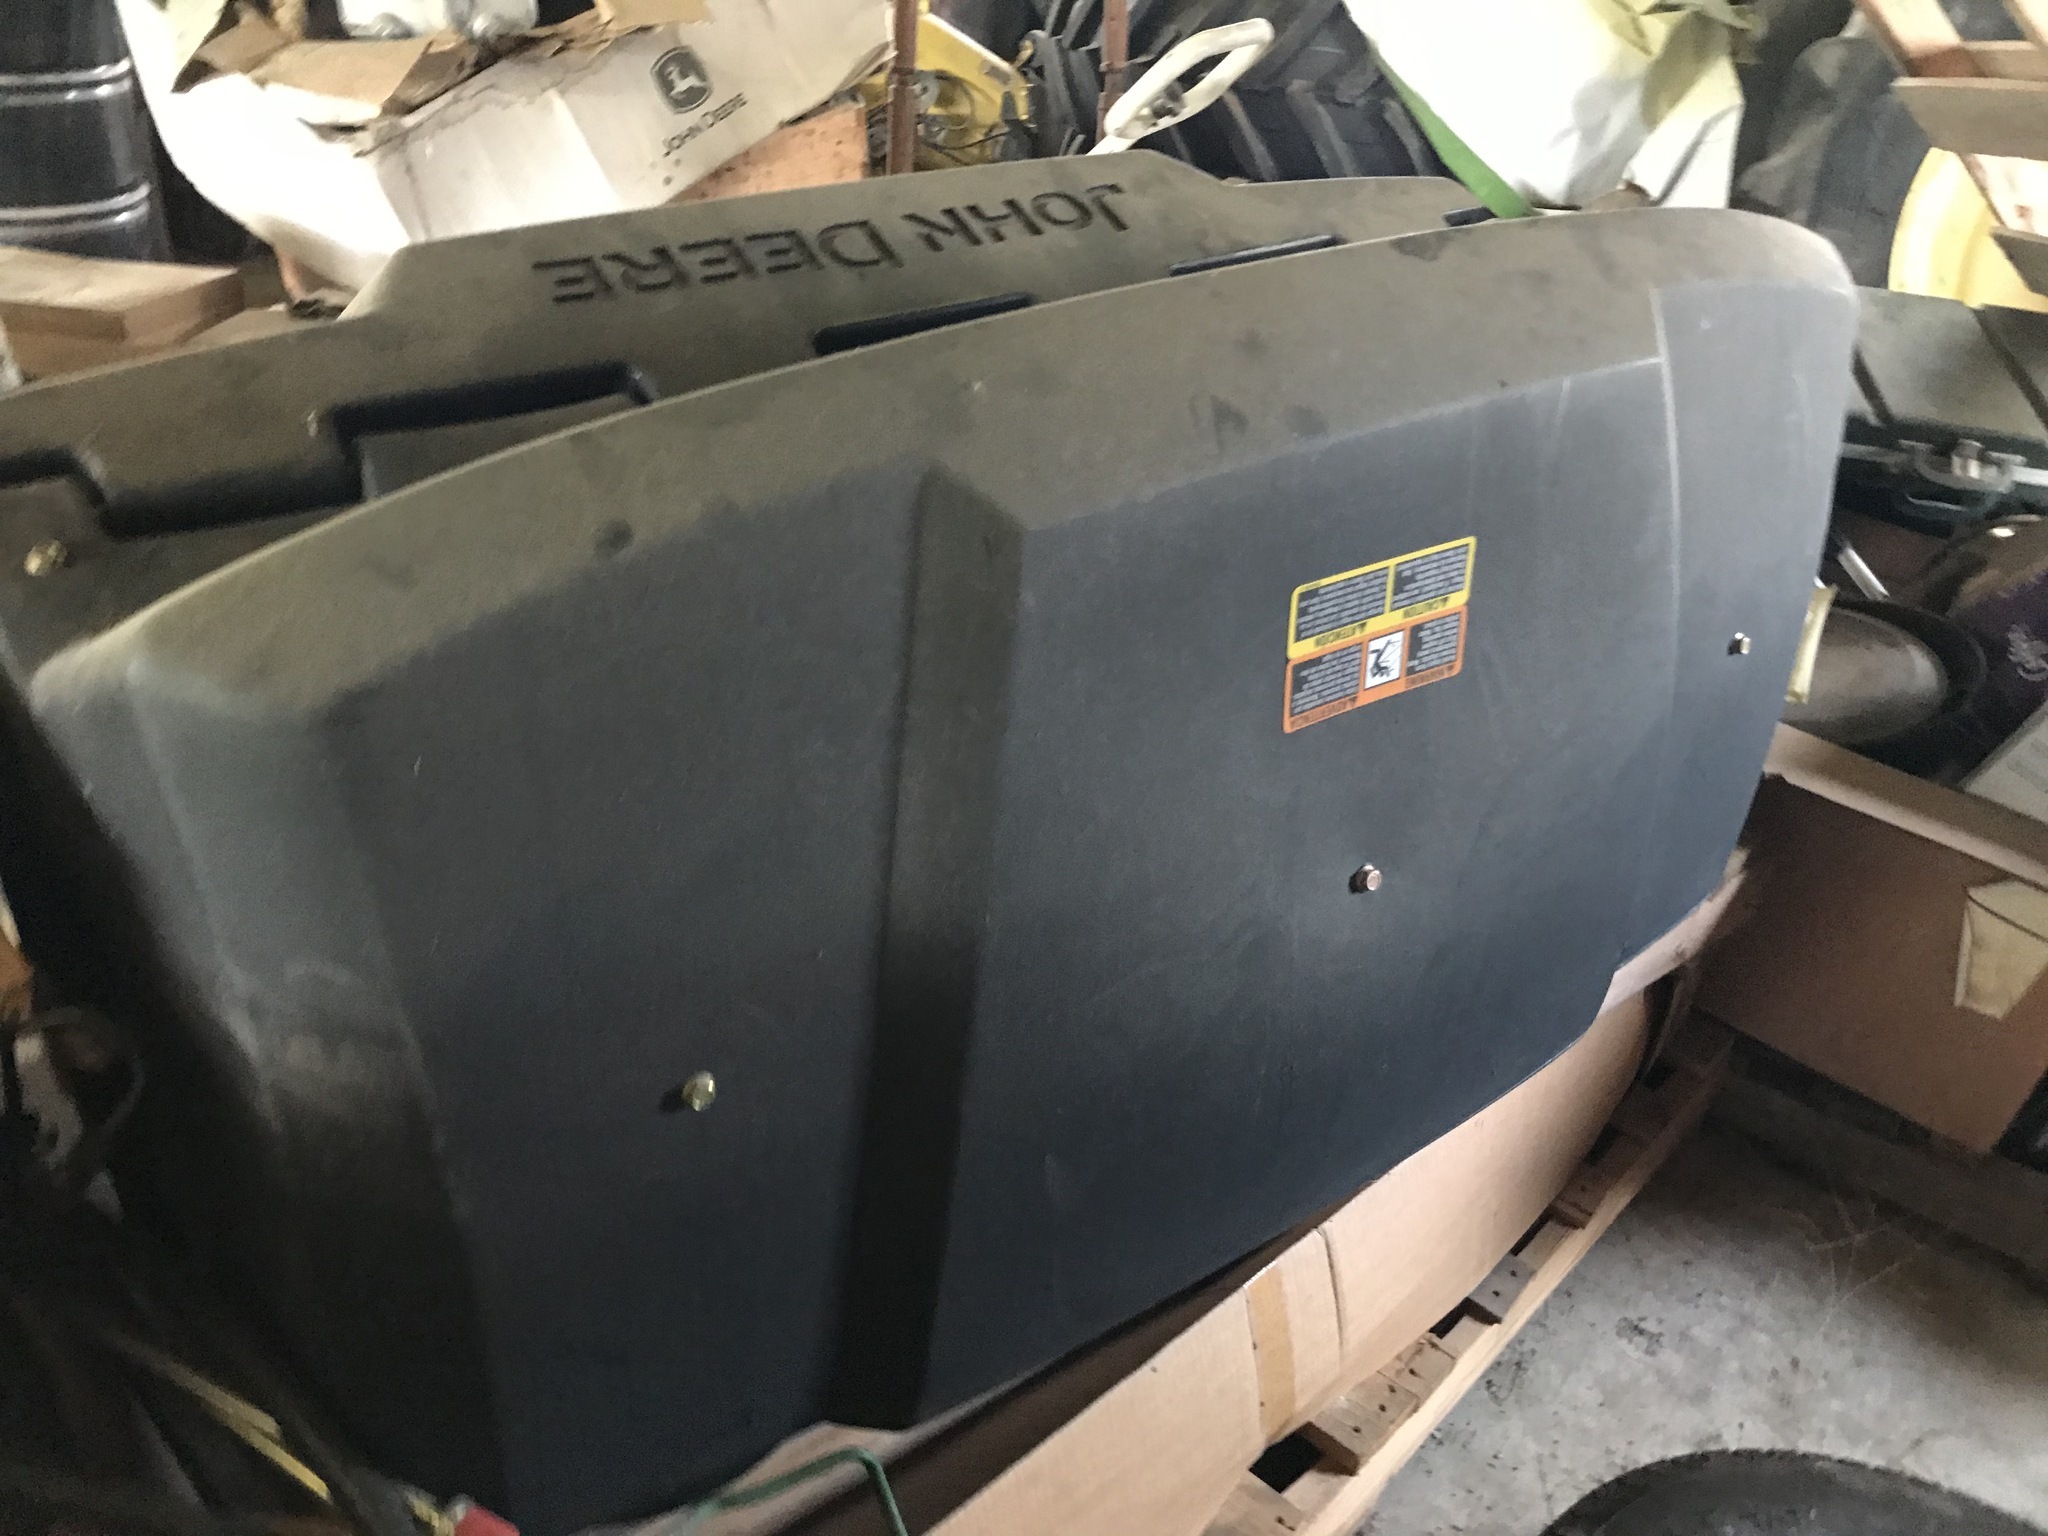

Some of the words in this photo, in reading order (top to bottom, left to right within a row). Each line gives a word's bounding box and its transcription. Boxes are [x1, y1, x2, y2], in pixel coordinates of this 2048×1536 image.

[662, 125, 702, 158] JOHN
[701, 92, 748, 129] DEERE
[902, 184, 1130, 253] JOHN
[532, 219, 903, 304] DEERE
